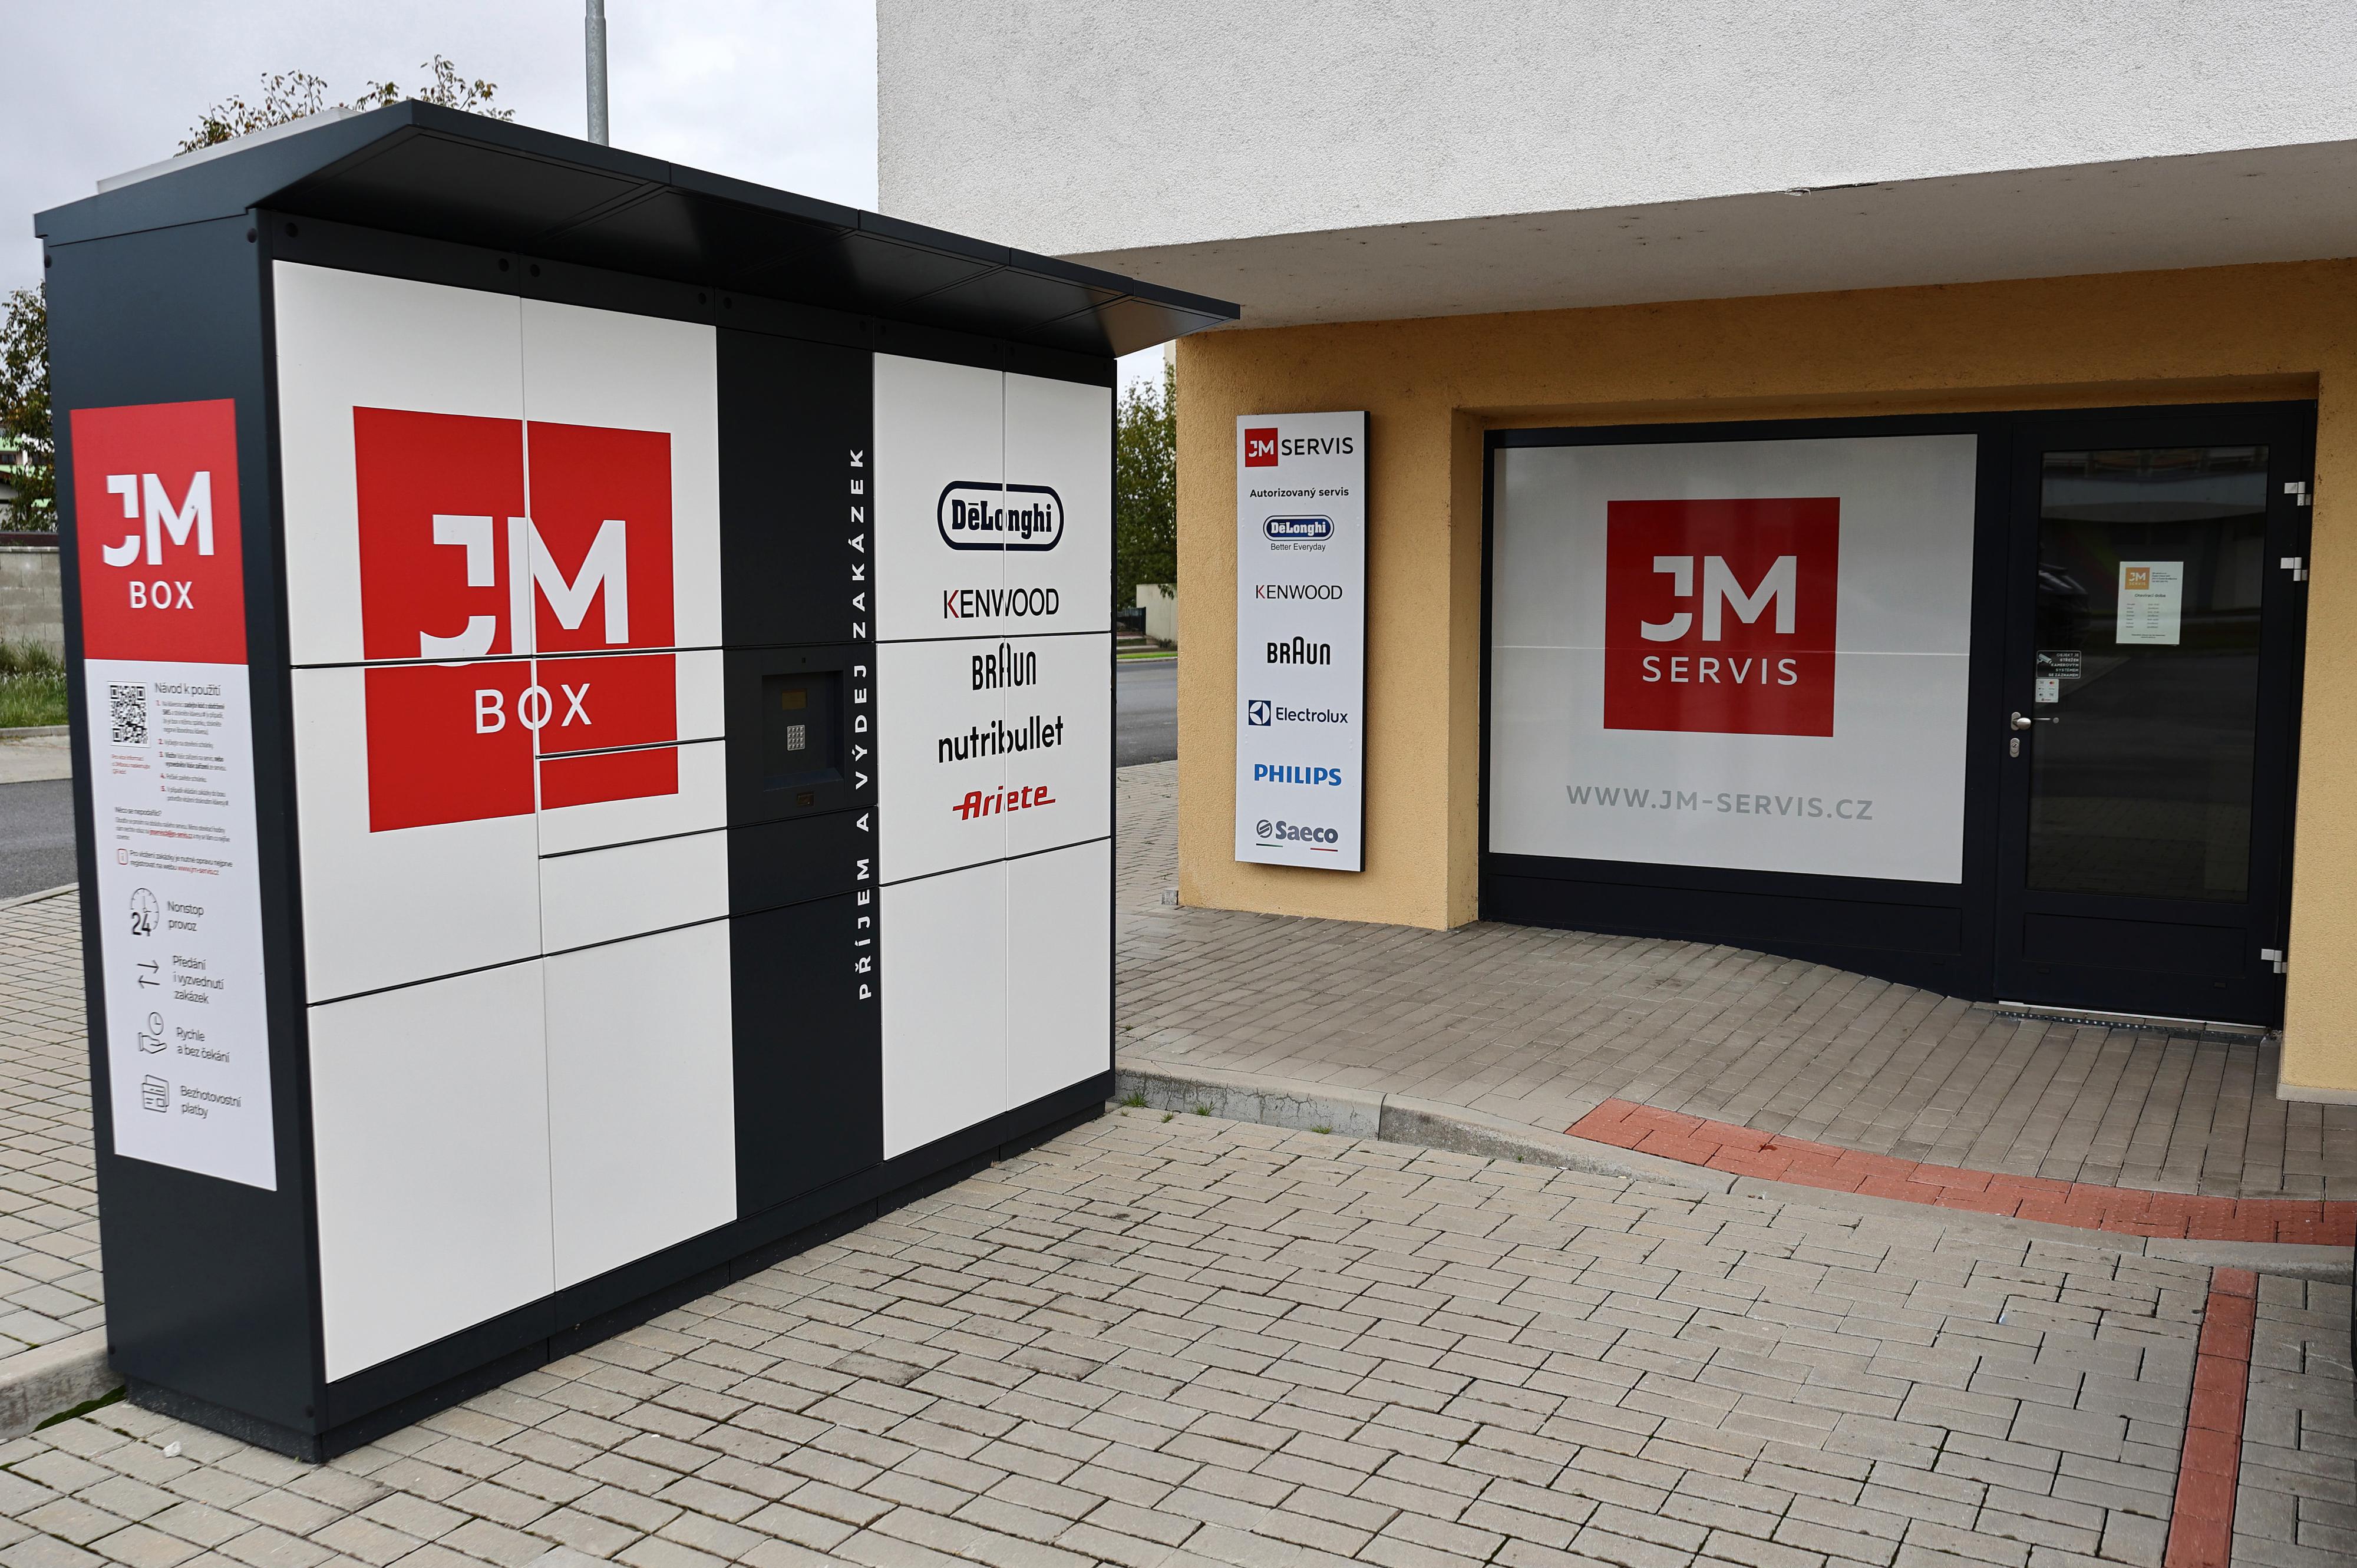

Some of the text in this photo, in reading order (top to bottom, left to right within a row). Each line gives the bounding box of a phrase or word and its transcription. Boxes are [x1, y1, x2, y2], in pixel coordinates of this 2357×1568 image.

[1248, 437, 1354, 457] JM SERVIS
[1250, 487, 1349, 499] Autorizovaný servis
[102, 471, 214, 567] JM
[1293, 543, 1326, 552] Everyday
[129, 580, 194, 609] BOX
[420, 514, 629, 666] JM
[1256, 585, 1343, 600] KENWOOD
[1640, 556, 1797, 642] JM
[943, 588, 1059, 619] KENWOOD
[1267, 636, 1331, 665] BRAUN
[972, 642, 1036, 690] BRAUN
[1642, 656, 1798, 685] SERVIS
[155, 682, 182, 694] Návod
[475, 683, 592, 734] BOX
[1276, 707, 1348, 724] Electrolux
[848, 450, 872, 1000] PŘÍJEM A VÝDEJ ZAKÁZEK
[938, 715, 1064, 763] nutribullet
[1254, 764, 1342, 786] PHILIPS
[952, 785, 1056, 820] Ariete
[1566, 785, 1873, 820] WWW.JM-SERVIS.CZ
[1275, 820, 1338, 843] Saeco
[167, 900, 204, 916] Nonstop
[131, 912, 151, 936] 24
[168, 919, 197, 932] provoz
[173, 955, 206, 971] Předání
[178, 973, 225, 991] vyzvednutí
[174, 990, 209, 1004] zakázek
[176, 1027, 205, 1042] Rychle
[183, 1044, 199, 1057] bez
[201, 1046, 230, 1063] čekání
[180, 1085, 242, 1108] Bezhotovostní
[181, 1102, 209, 1119] platby
